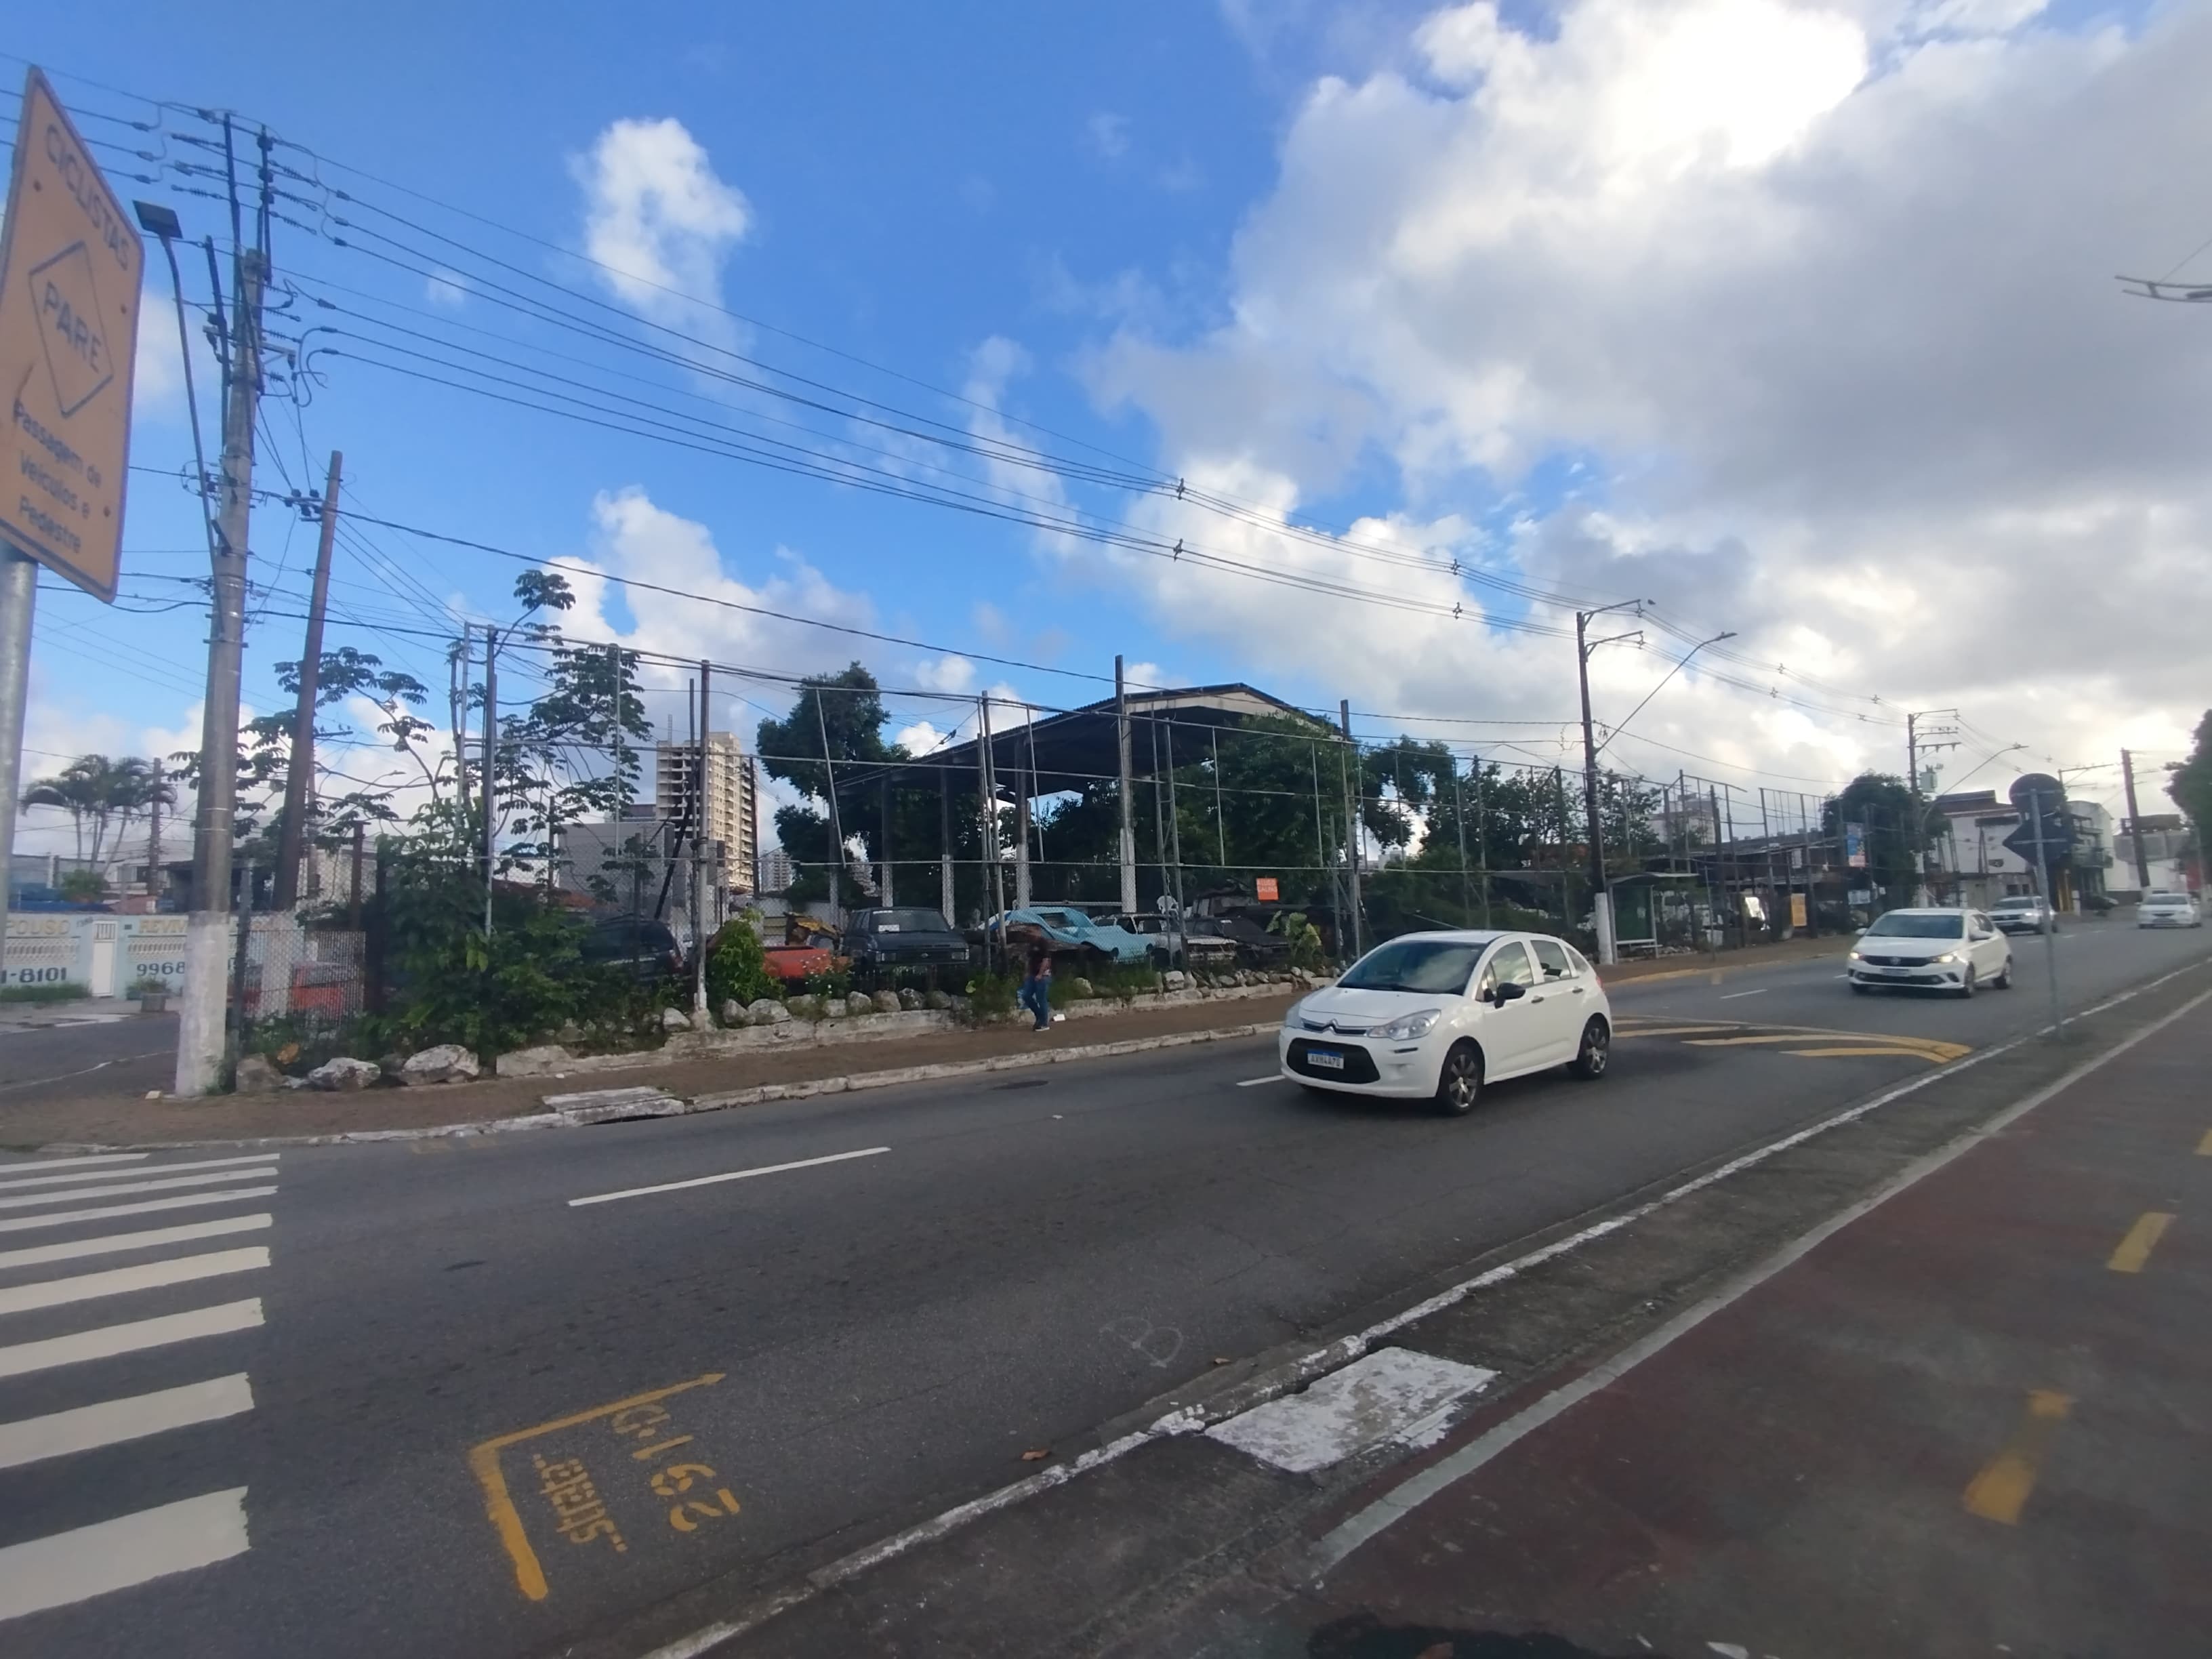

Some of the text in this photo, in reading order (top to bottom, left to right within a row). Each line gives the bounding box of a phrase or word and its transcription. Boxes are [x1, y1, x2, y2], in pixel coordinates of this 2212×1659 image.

[46, 123, 129, 271] CICLISTAS
[43, 280, 102, 373] PARE
[13, 398, 101, 488] Passagem de
